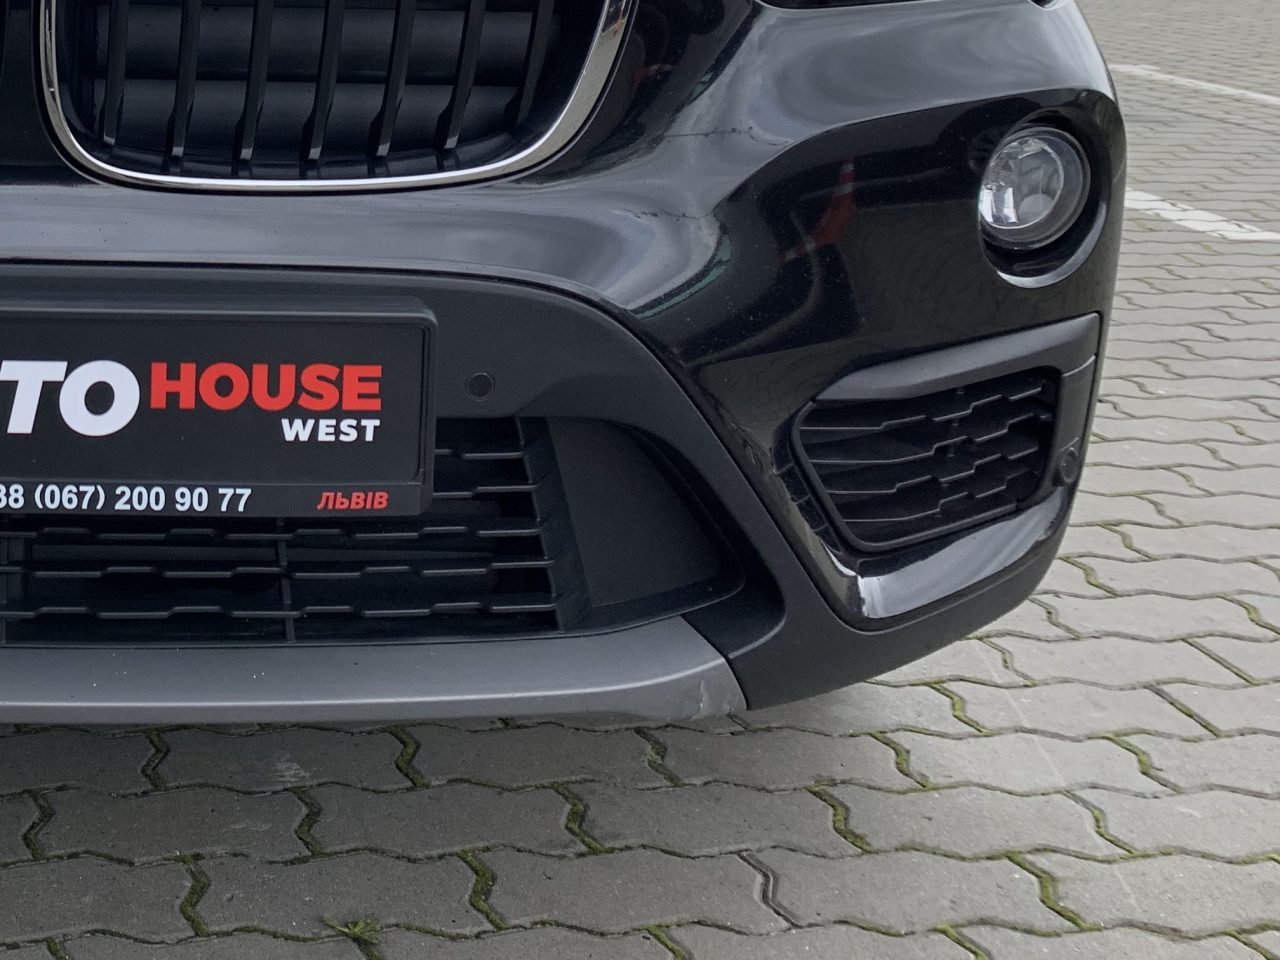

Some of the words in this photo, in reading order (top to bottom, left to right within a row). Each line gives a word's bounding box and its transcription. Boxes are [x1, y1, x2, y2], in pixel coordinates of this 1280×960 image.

[150, 362, 382, 411] HOUSE
[281, 419, 380, 442] WEST
[34, 484, 106, 510] (067)
[114, 486, 166, 511] 200
[175, 487, 209, 512] 90
[218, 488, 252, 512] 77
